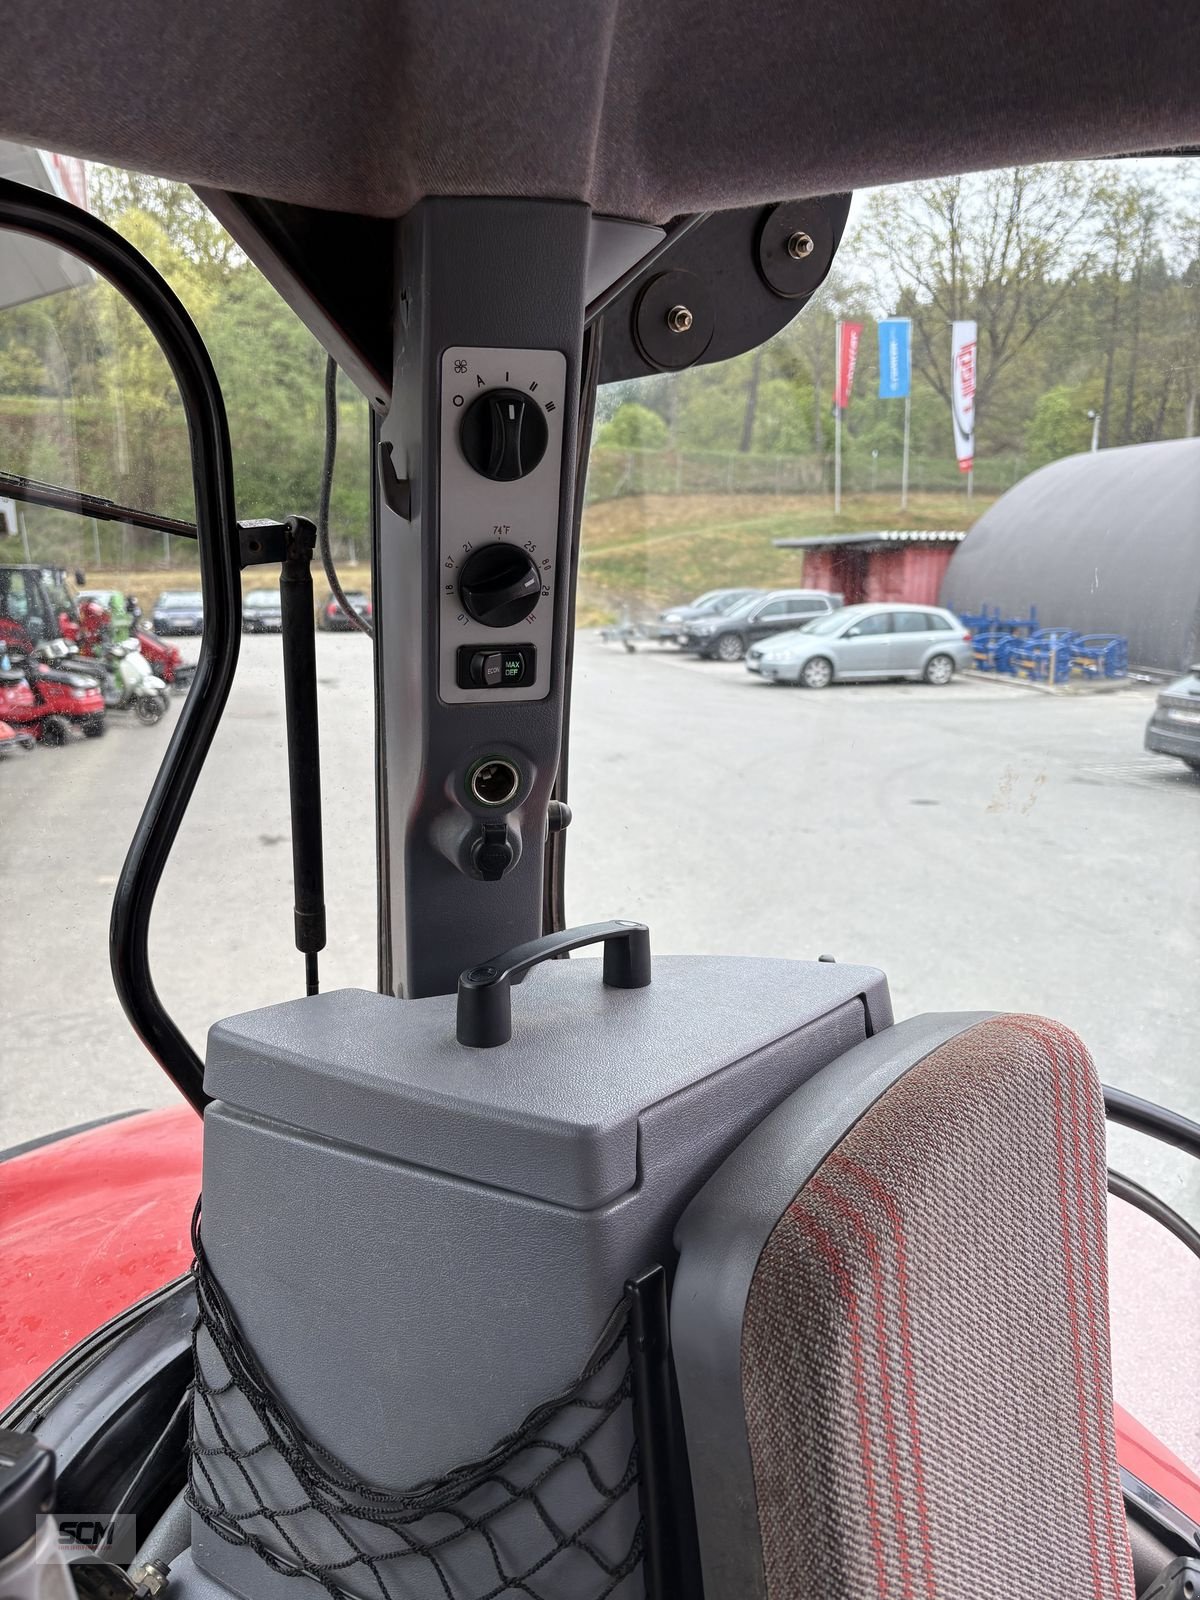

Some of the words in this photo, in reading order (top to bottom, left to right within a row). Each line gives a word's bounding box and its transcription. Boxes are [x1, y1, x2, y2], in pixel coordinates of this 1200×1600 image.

[476, 374, 486, 388] A
[462, 541, 473, 553] 21
[523, 540, 537, 553] 25
[444, 556, 455, 569] 67
[445, 584, 454, 596] 18
[541, 585, 551, 597] 28
[456, 614, 470, 626] LO
[525, 613, 537, 625] HI
[505, 660, 520, 669] MAX
[505, 669, 518, 677] DEF
